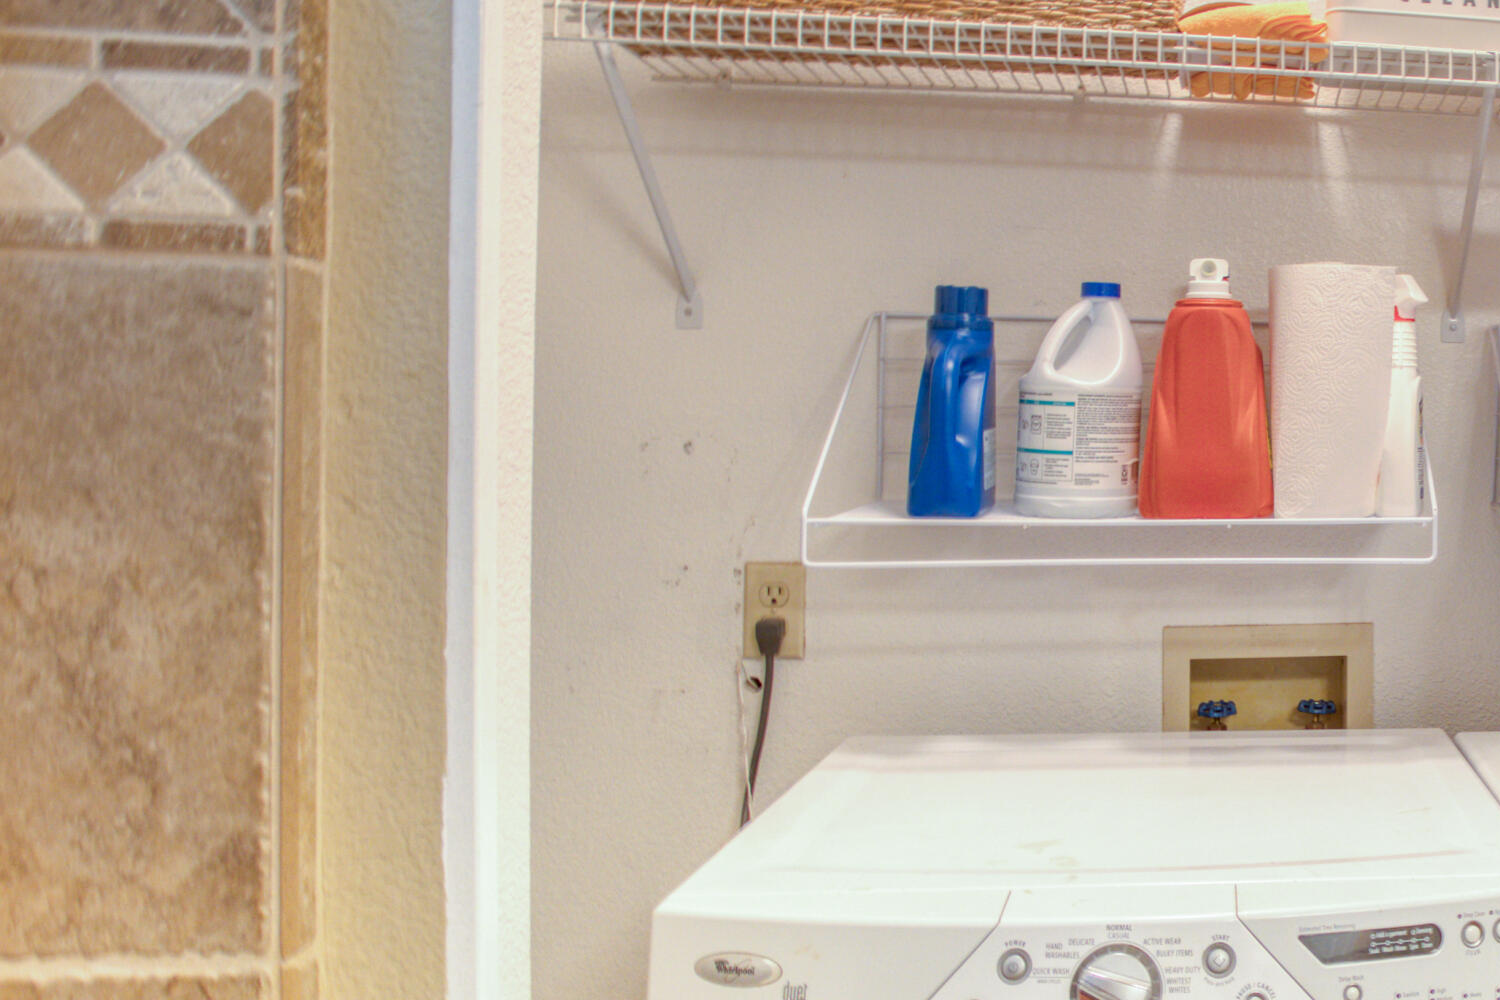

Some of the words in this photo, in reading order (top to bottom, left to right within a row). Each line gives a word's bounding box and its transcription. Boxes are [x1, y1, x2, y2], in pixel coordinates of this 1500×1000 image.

[1106, 924, 1132, 932] NORMAL
[1107, 931, 1130, 940] CASUAL
[1212, 934, 1230, 942] START
[1004, 939, 1027, 948] POWER
[1068, 938, 1095, 946] DELICATE
[1143, 938, 1163, 946] ACTIVE
[1164, 937, 1182, 945] WEAR
[1046, 942, 1064, 950] HAND
[1045, 951, 1080, 960] WASHABLES
[1156, 949, 1175, 957] BULKY
[1175, 949, 1194, 957] ITEMS
[714, 959, 755, 977] Whirlpool
[1032, 967, 1051, 976] QUICK
[1052, 967, 1070, 975] WASH
[1164, 966, 1184, 974] HEAVY
[1185, 966, 1201, 974] DUTY
[1168, 986, 1191, 994] WHITES
